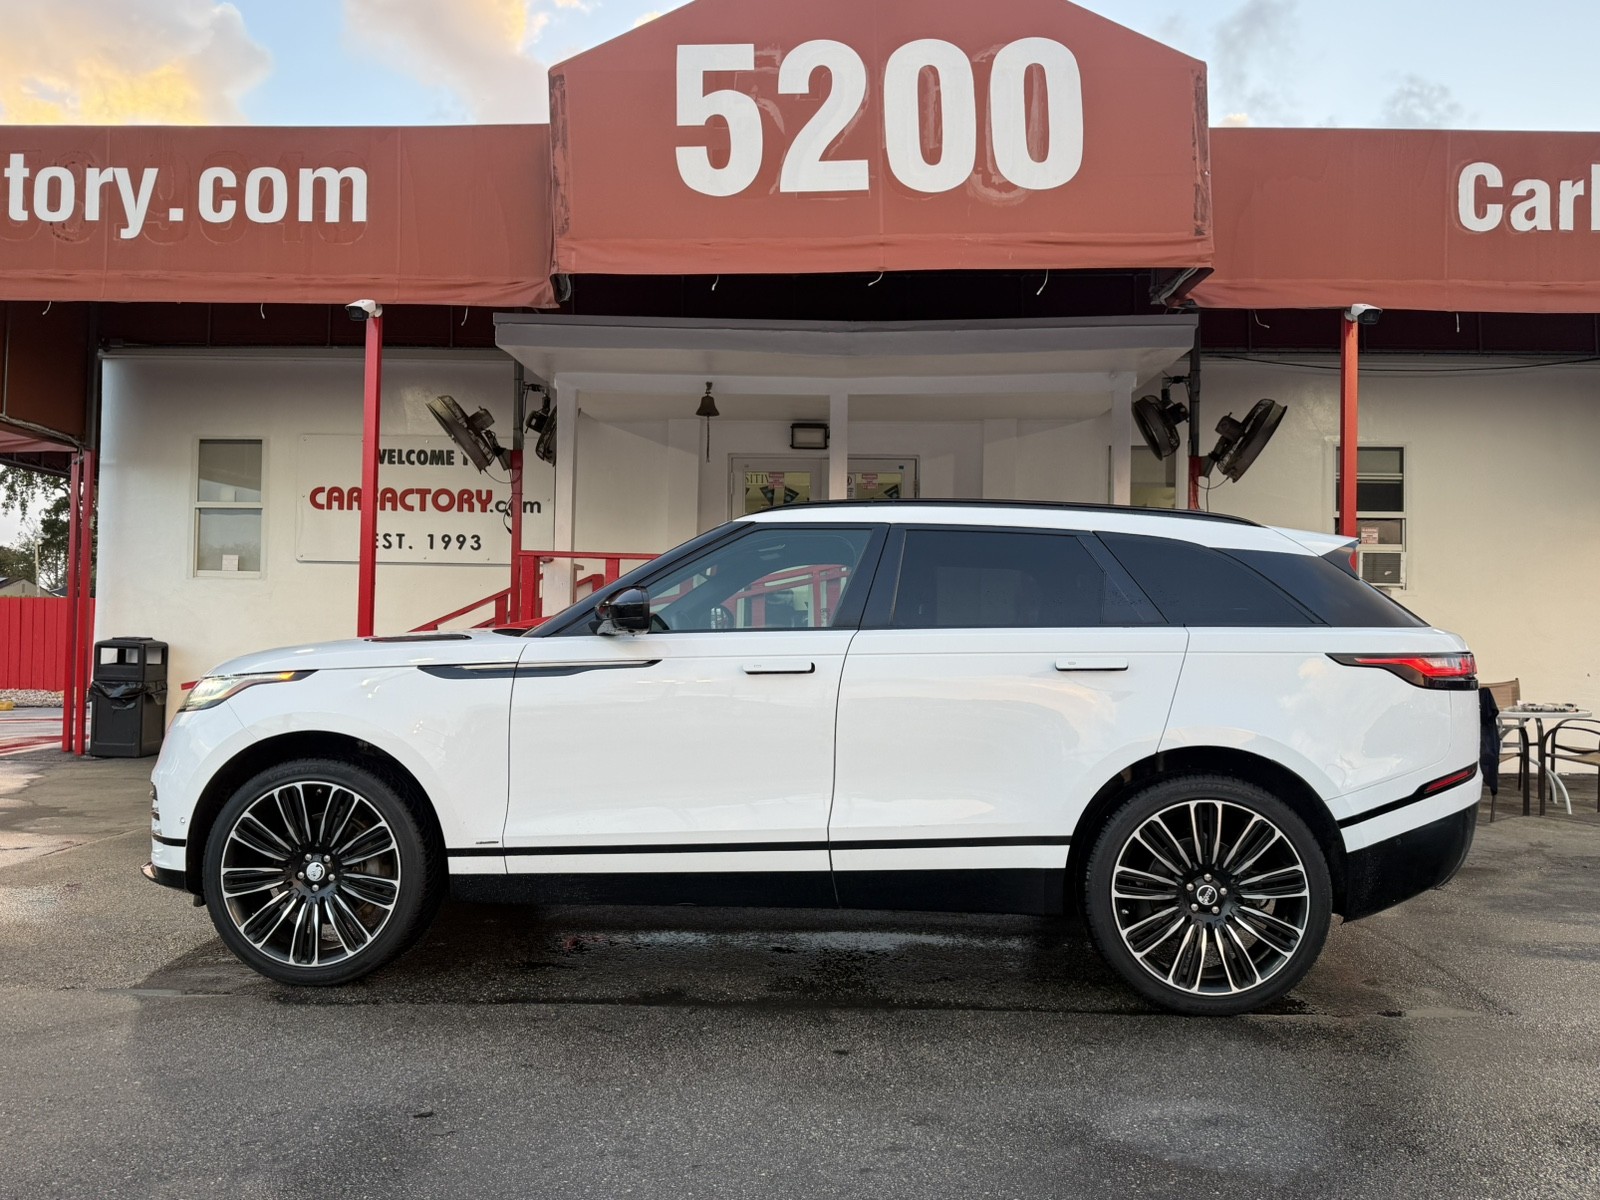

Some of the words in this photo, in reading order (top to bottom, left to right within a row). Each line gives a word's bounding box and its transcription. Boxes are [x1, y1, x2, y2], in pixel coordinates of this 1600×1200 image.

[675, 36, 1084, 197] 5200
[309, 486, 541, 514] CARACTORY.cm
[427, 533, 482, 551] 1993
